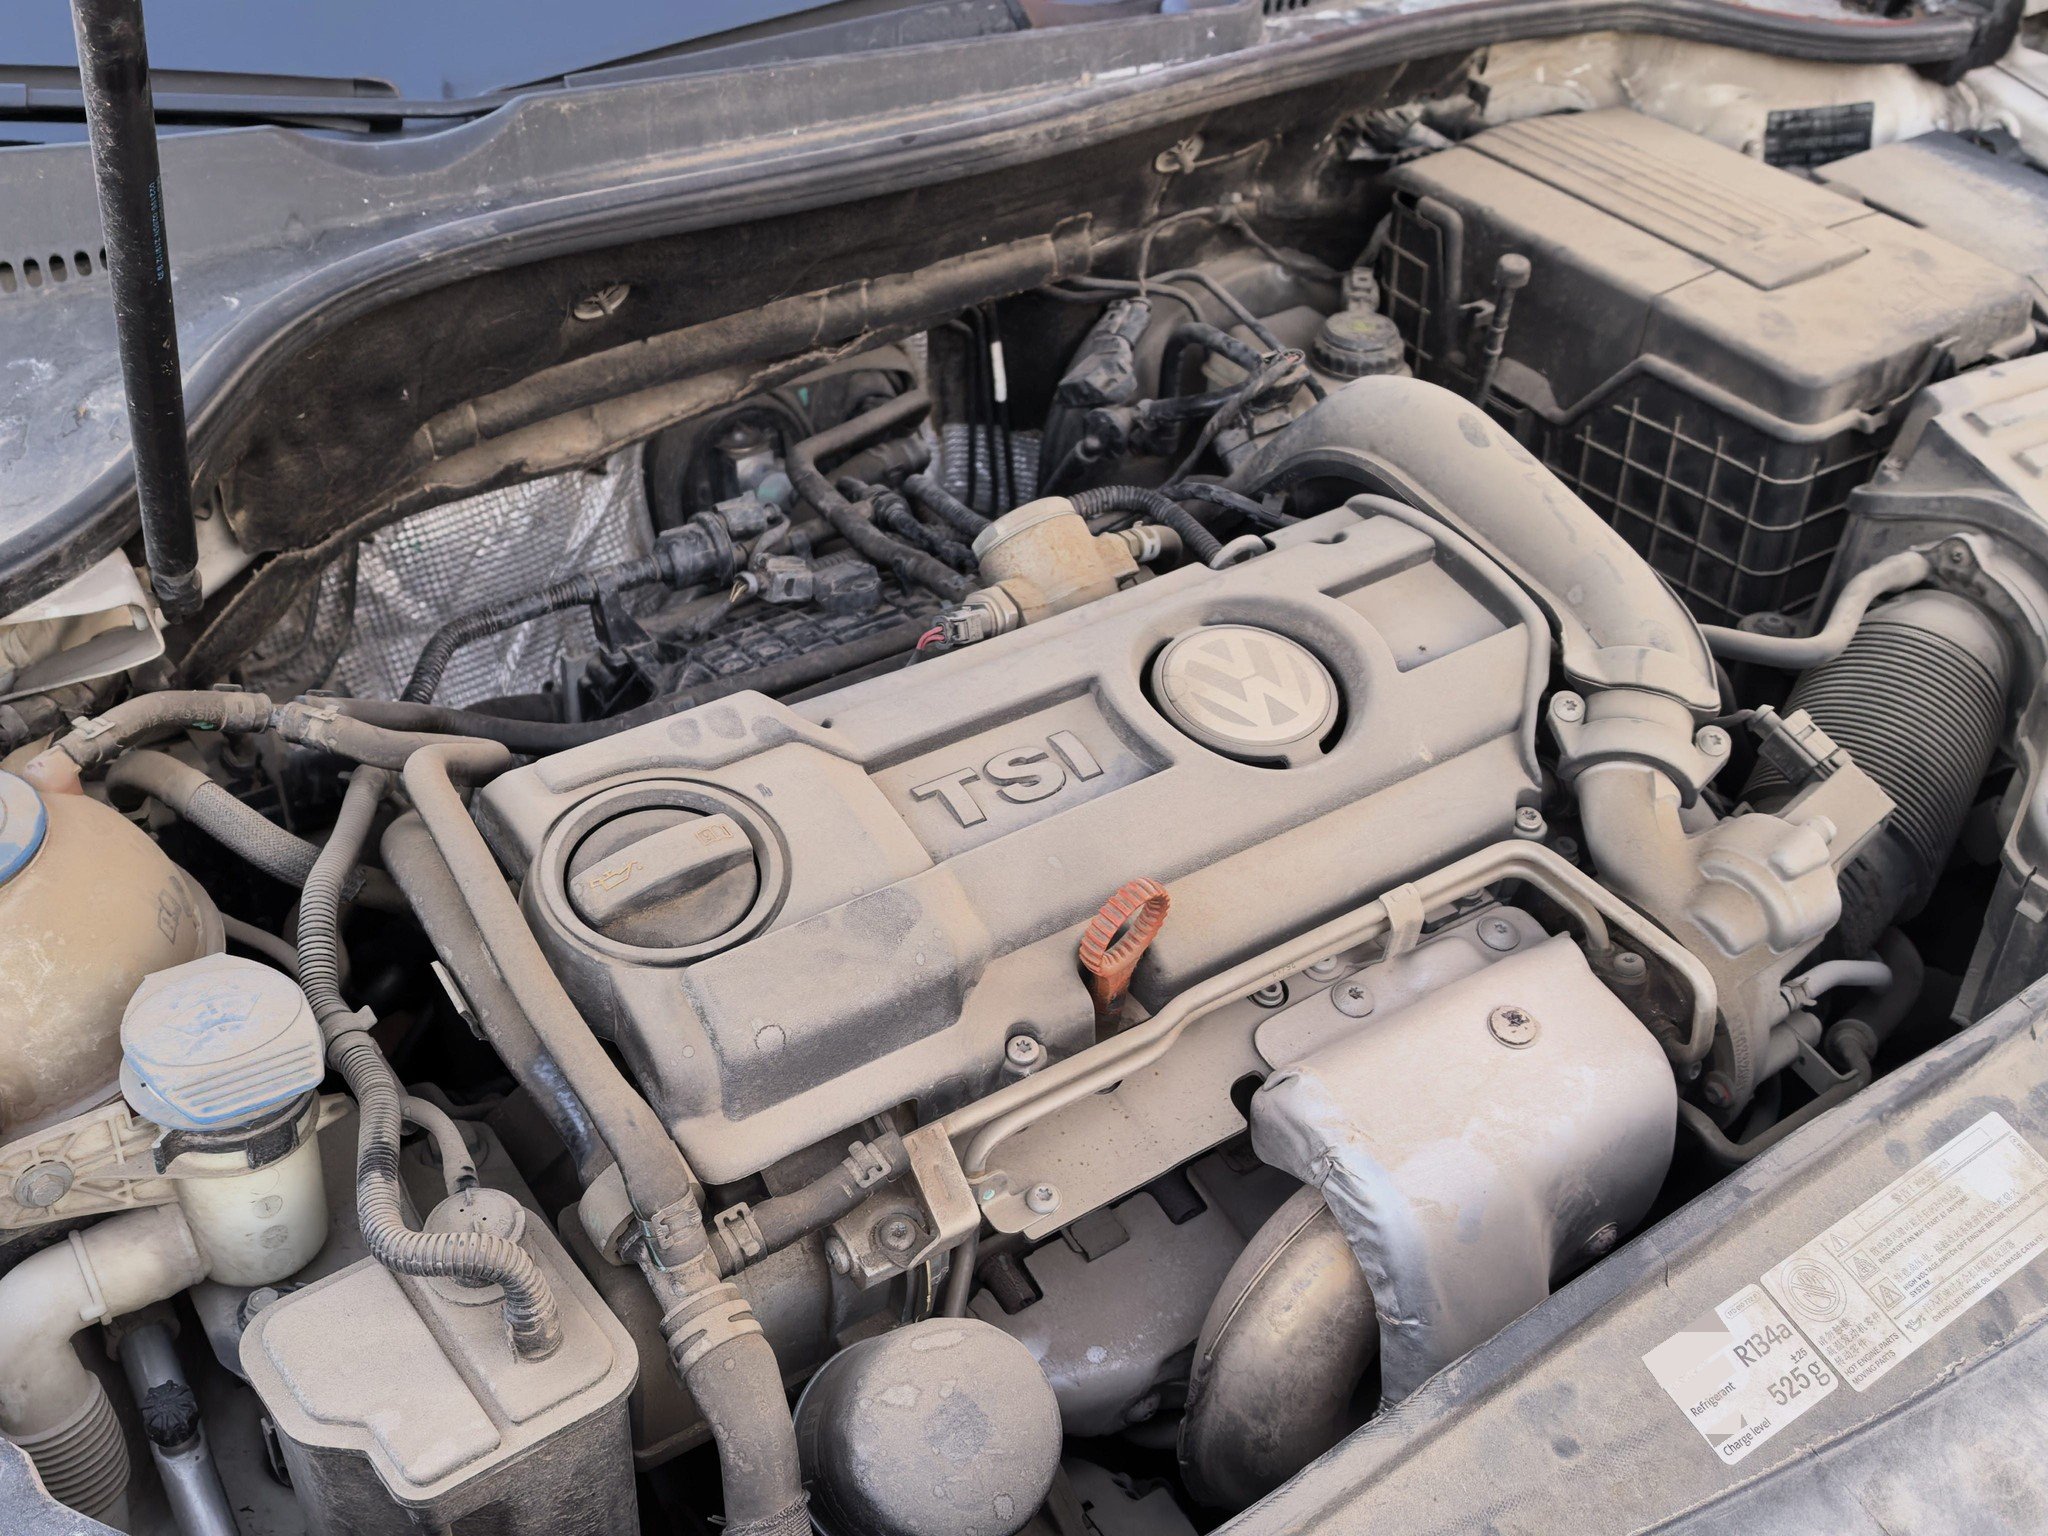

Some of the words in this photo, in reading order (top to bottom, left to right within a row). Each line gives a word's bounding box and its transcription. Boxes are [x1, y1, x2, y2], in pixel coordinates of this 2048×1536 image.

[910, 730, 1104, 828] TSI
[1879, 1242, 1906, 1264] RADIATOR
[1903, 1234, 1916, 1246] FAN
[1913, 1227, 1925, 1239] MAY
[1924, 1217, 1940, 1230] START
[1938, 1211, 1948, 1220] AT
[1903, 1277, 1918, 1292] HIGH
[1938, 1247, 1958, 1264] SWITCH
[1957, 1239, 1968, 1251] OFF
[1967, 1225, 1986, 1243] ENGINE
[1985, 1210, 2007, 1230] BEFORE
[2004, 1193, 2030, 1214] TOUCHING
[1932, 1295, 1964, 1323] OVERFILLED
[1962, 1282, 1982, 1300] ENGINE
[1980, 1275, 1991, 1286] OIL
[1989, 1265, 2001, 1279] CAN
[1999, 1250, 2022, 1272] DAMAGE
[2020, 1233, 2046, 1255] CATALYST
[1733, 1322, 1794, 1367] R134a
[1790, 1347, 1808, 1364] ±25
[1844, 1361, 1860, 1377] HOT
[1857, 1345, 1882, 1368] ENGINE
[1878, 1332, 1900, 1355] PARTS
[1851, 1363, 1878, 1385] MOVING
[1875, 1349, 1896, 1371] PARTS
[1690, 1381, 1737, 1417] Refrigerant
[1767, 1366, 1811, 1406] 525
[1807, 1360, 1831, 1387] g
[1723, 1429, 1757, 1457] Charge
[1752, 1417, 1772, 1437] level
